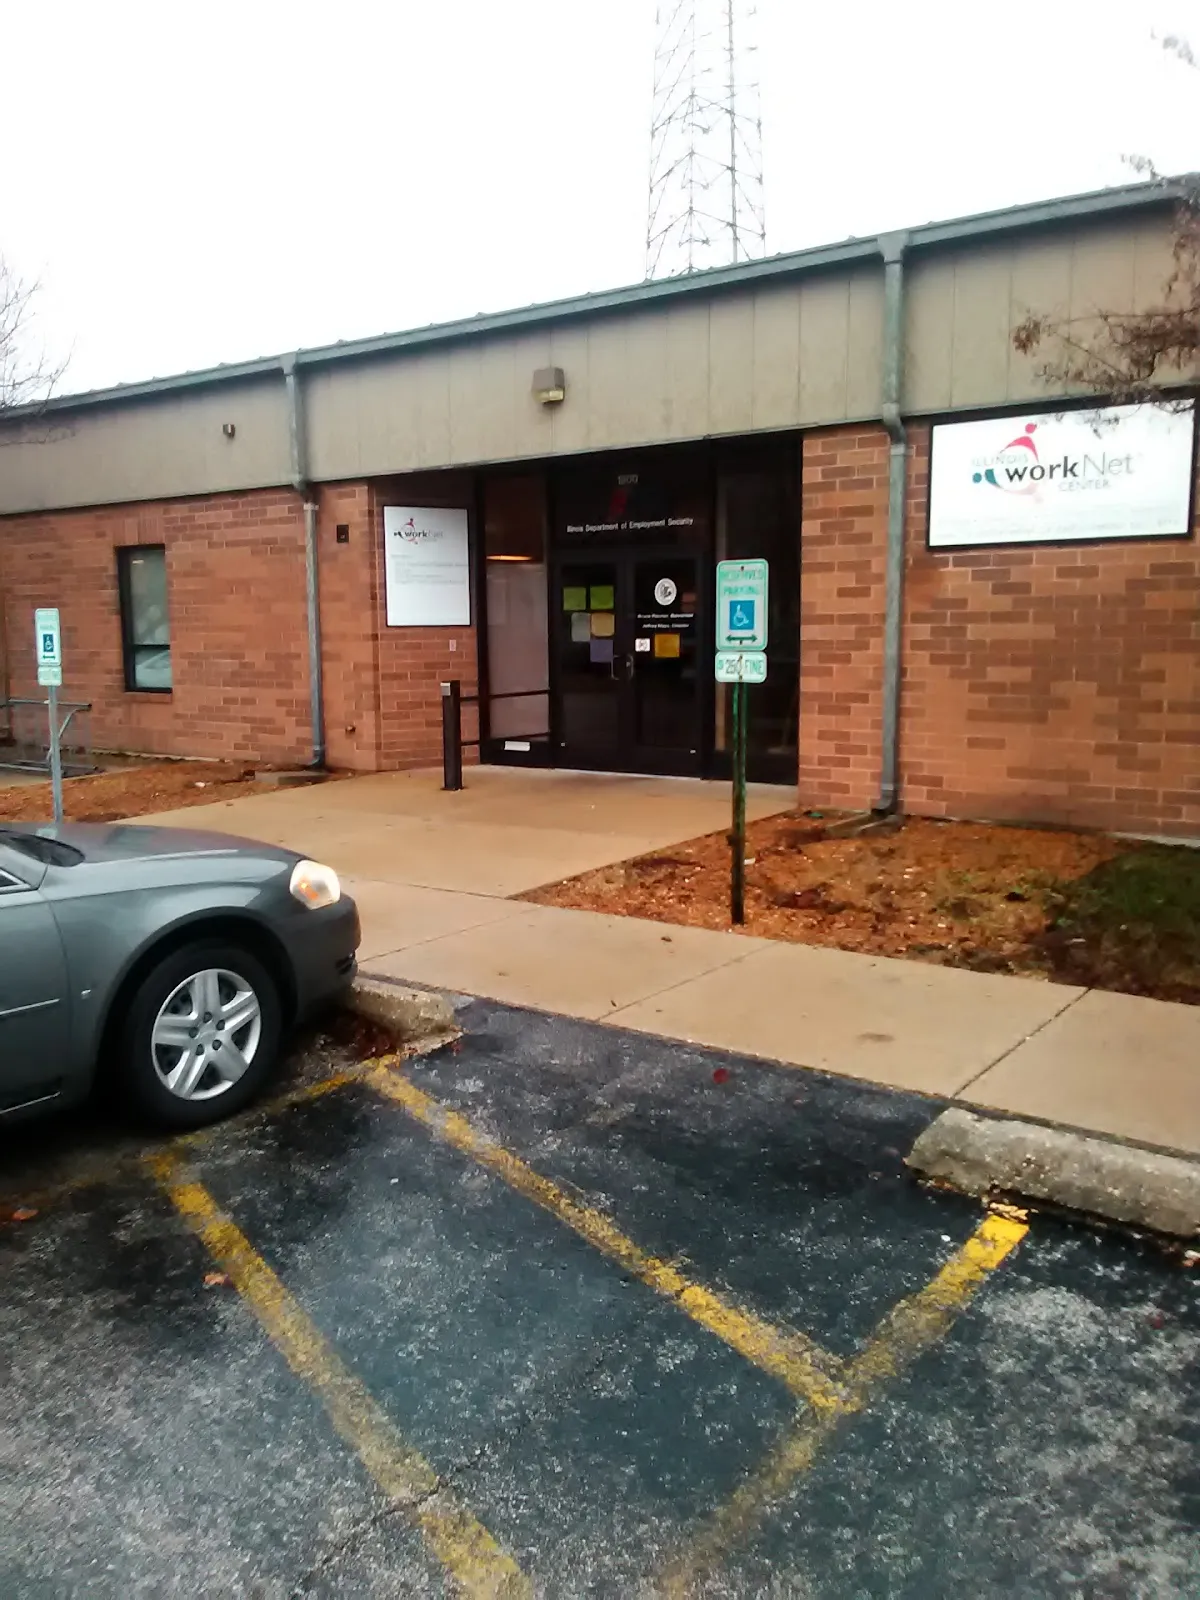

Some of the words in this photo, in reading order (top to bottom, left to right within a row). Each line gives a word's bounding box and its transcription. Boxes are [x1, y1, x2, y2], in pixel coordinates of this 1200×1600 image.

[971, 453, 1029, 468] ILLINOIS
[1005, 452, 1136, 482] workNet
[1058, 479, 1111, 492] CENTER
[585, 523, 619, 533] Department
[620, 522, 628, 530] of
[629, 519, 666, 530] Employment
[667, 517, 694, 527] Security
[744, 659, 765, 675] FINE
